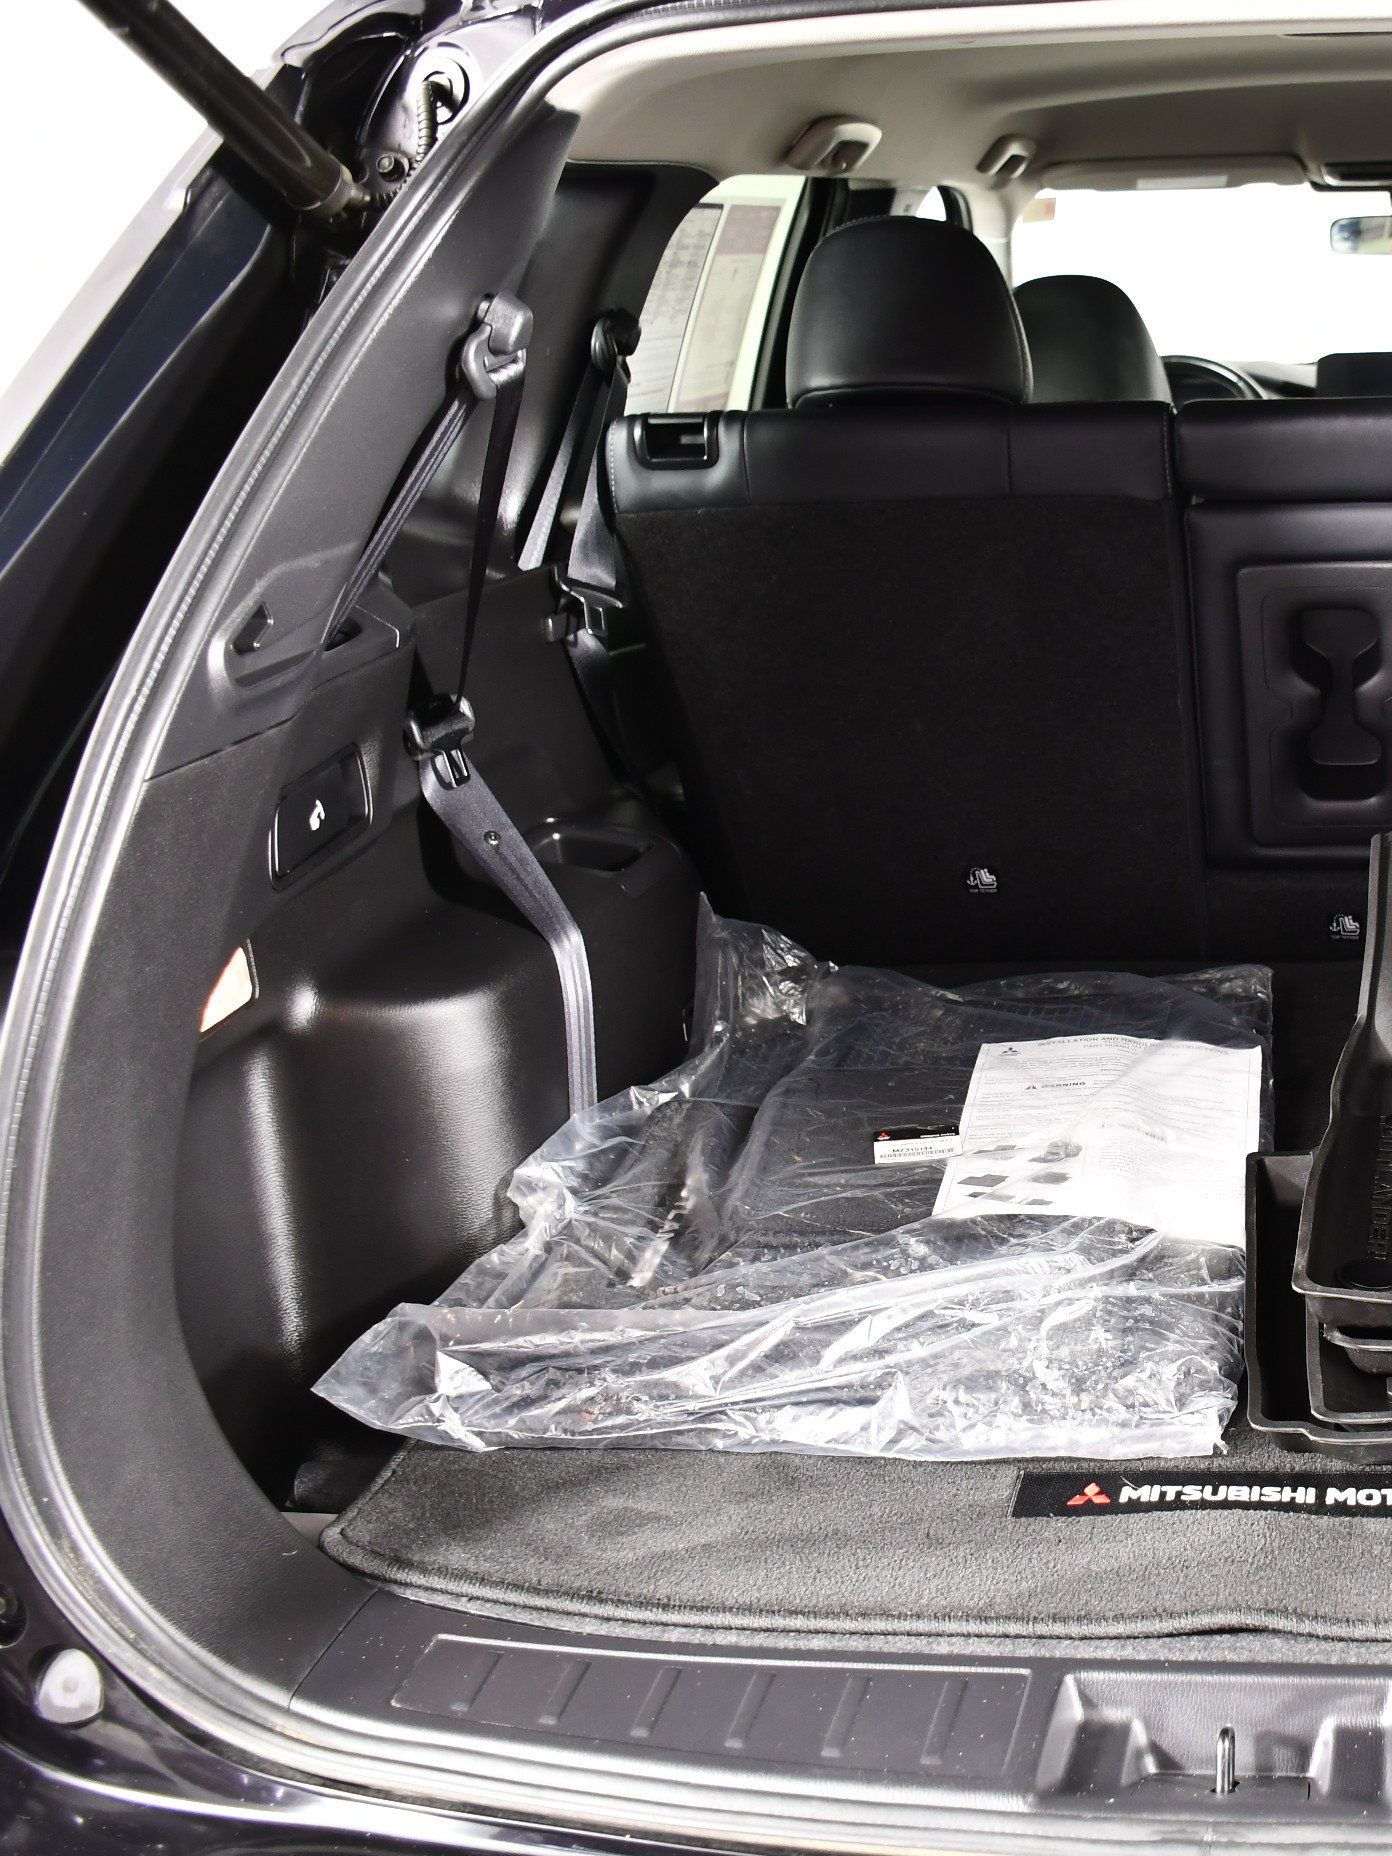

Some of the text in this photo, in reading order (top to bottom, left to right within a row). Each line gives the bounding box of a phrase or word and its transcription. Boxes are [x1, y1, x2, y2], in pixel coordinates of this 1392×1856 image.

[1036, 1037, 1099, 1047] INSTALLATION
[1040, 1081, 1086, 1089] WARNING
[1118, 1483, 1316, 1504] MITSUBISHI
